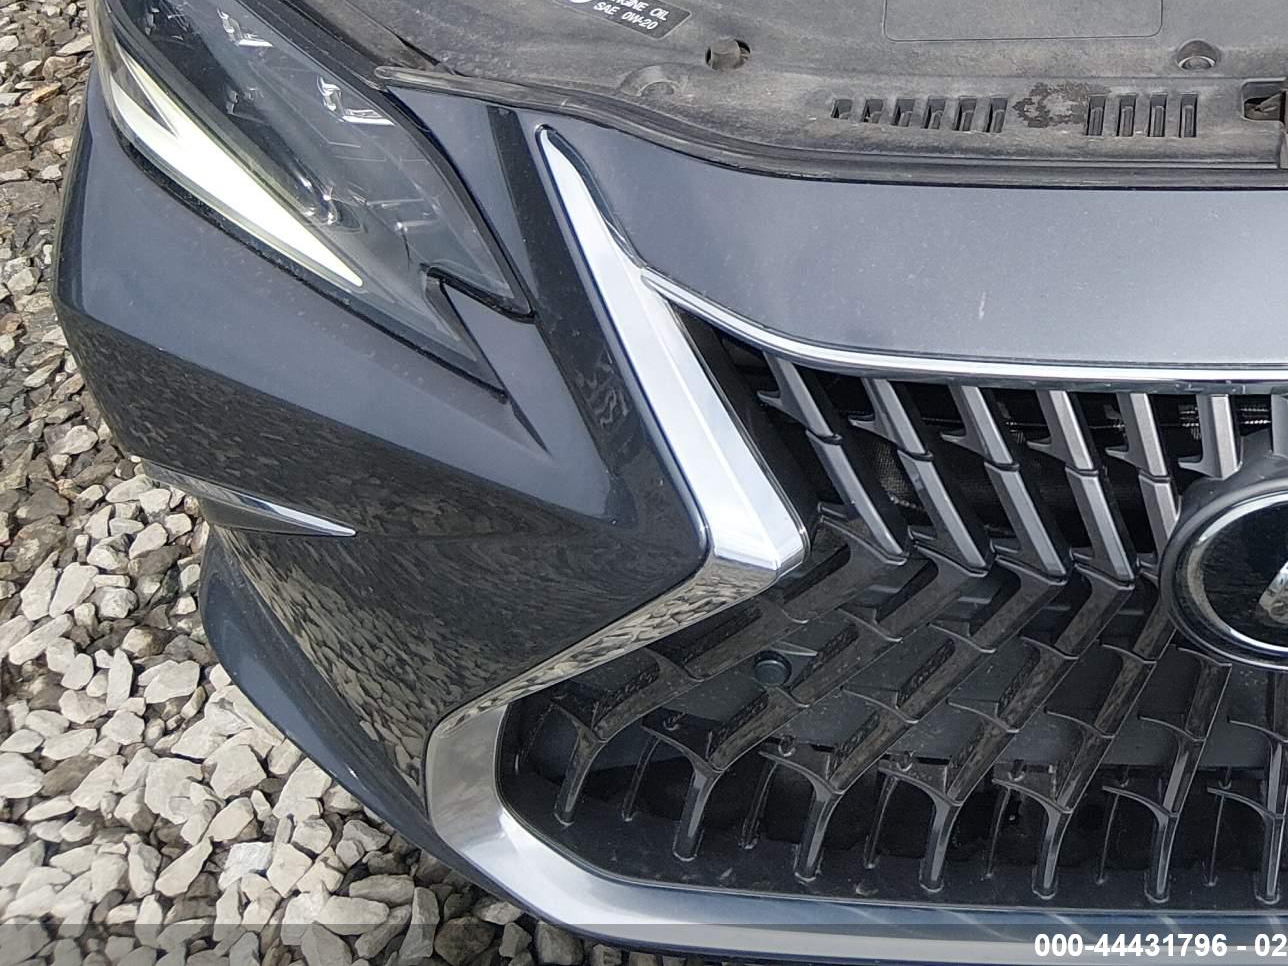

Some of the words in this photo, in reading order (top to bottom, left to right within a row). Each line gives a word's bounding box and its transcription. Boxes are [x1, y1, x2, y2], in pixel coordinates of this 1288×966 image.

[593, 1, 620, 15] SAE
[621, 11, 659, 30] 0W-20
[649, 7, 670, 21] OIL
